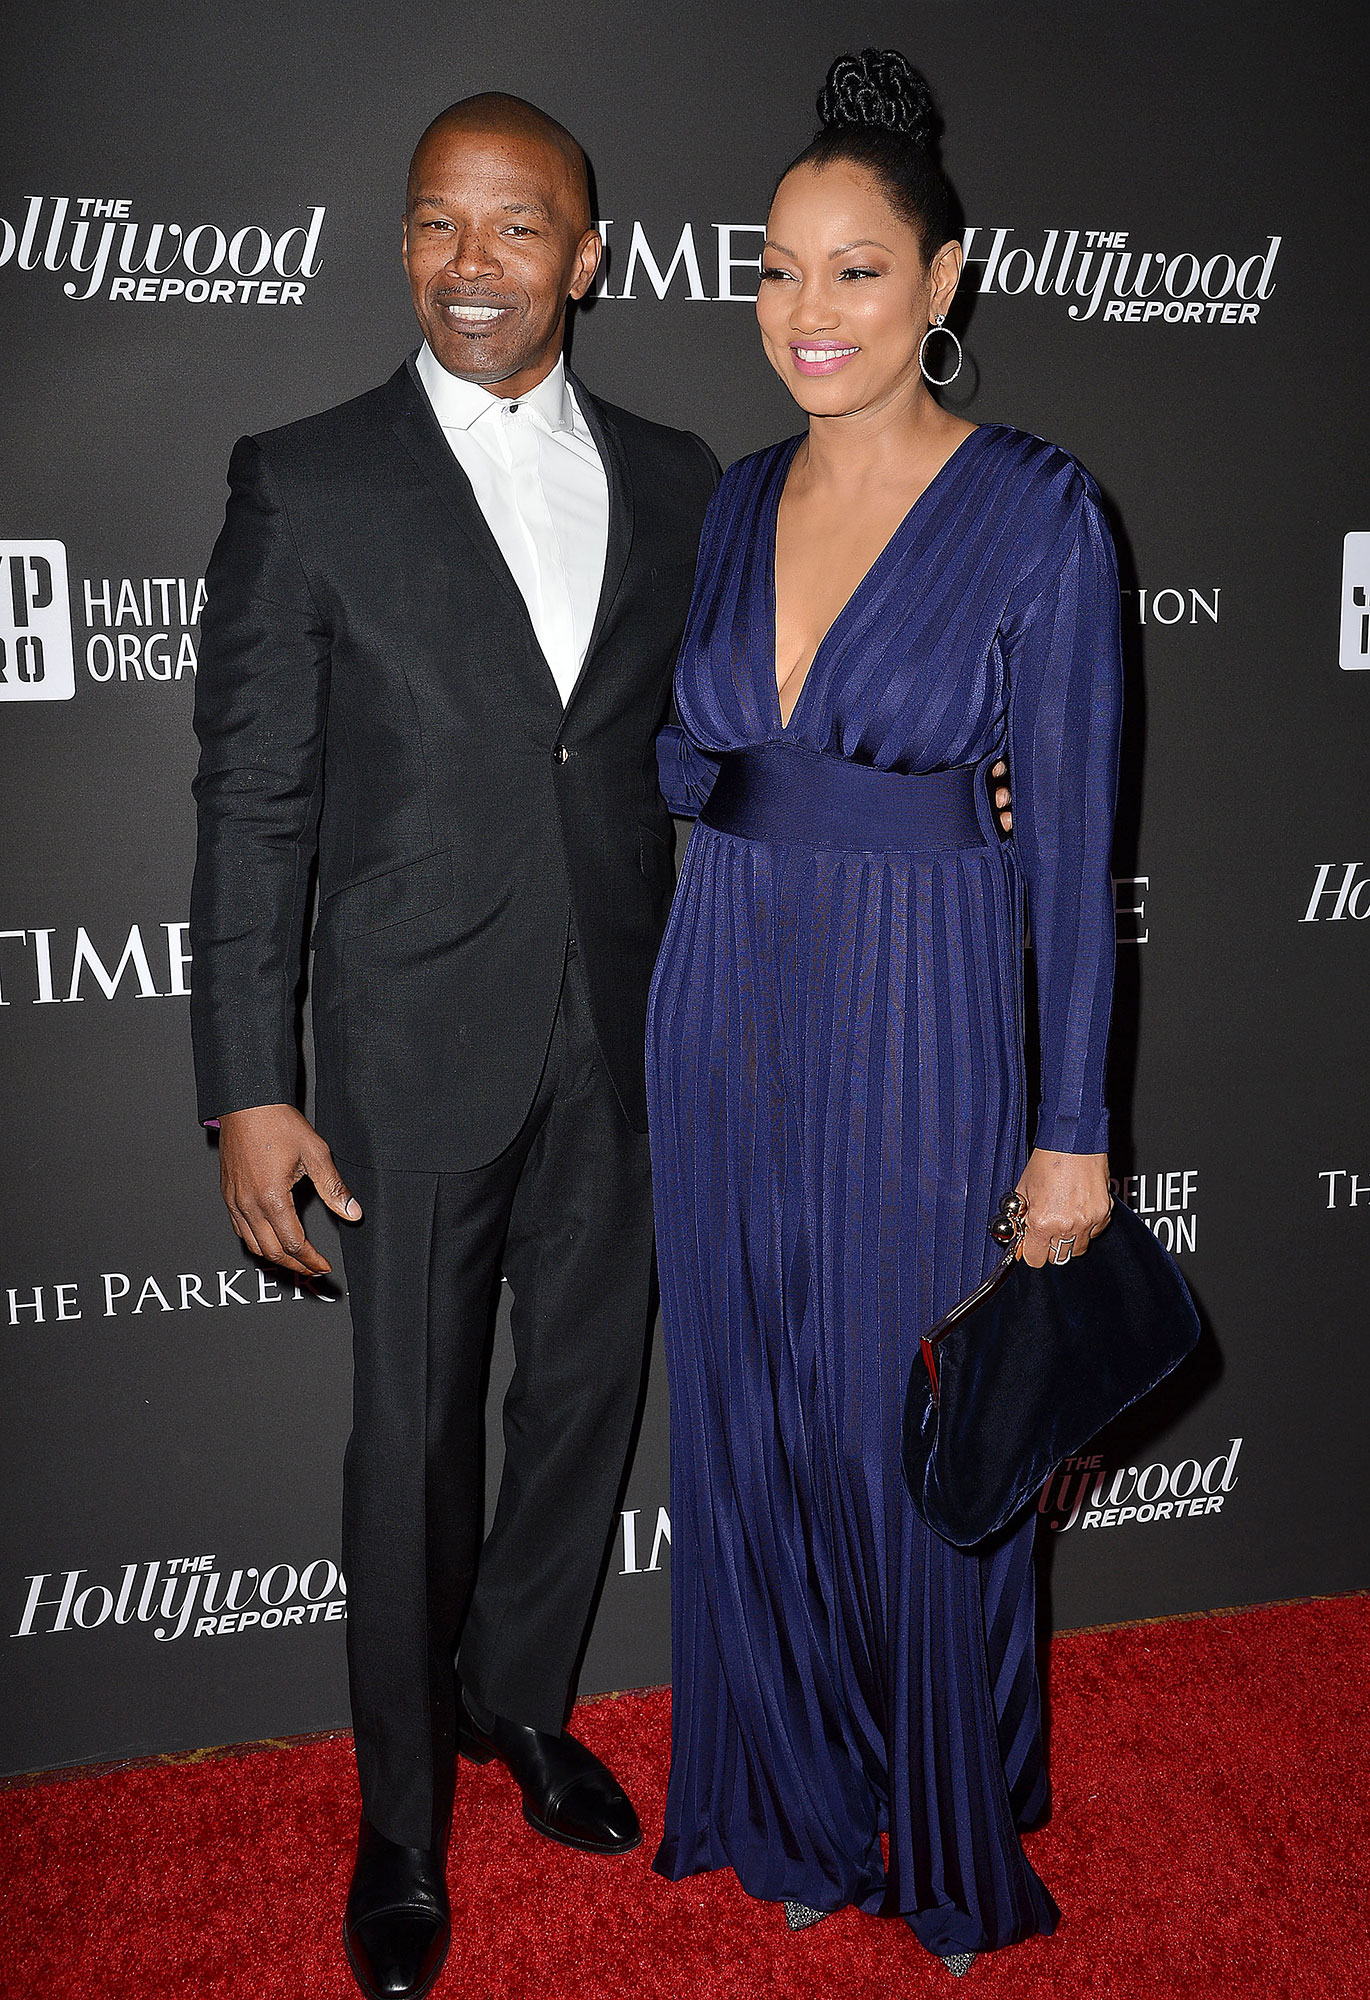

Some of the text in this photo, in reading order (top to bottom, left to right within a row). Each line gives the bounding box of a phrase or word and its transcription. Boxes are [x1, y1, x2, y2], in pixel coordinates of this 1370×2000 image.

[77, 198, 133, 219] THE
[1085, 231, 1129, 249] THE
[957, 228, 1282, 321] Hollywood
[109, 278, 306, 304] REPORTER
[1103, 300, 1261, 324] REPORTER
[1121, 588, 1221, 625] ION
[86, 633, 198, 682] ORGA
[1065, 1454, 1104, 1472] THE
[1081, 1495, 1225, 1530] REPORTER
[166, 1554, 216, 1574] THE
[10, 1559, 347, 1642] Hollywoo
[193, 1599, 347, 1638] REPORTE
